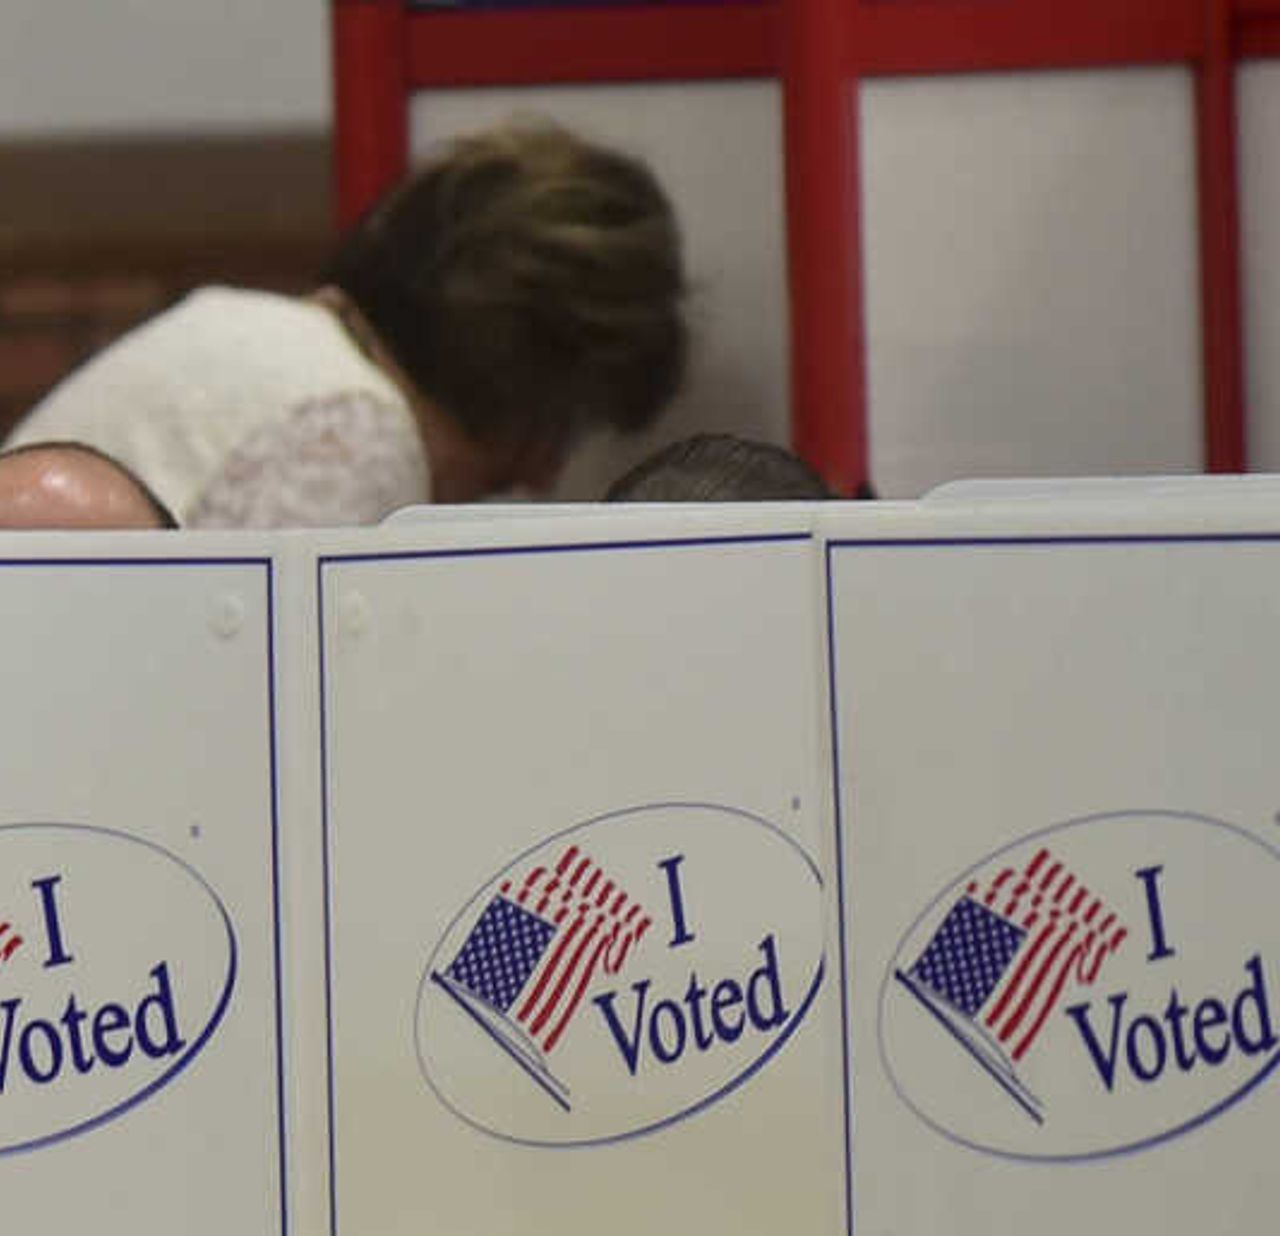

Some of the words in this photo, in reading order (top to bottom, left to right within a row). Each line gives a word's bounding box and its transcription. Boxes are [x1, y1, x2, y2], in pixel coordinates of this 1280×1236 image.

[31, 875, 74, 968] I
[657, 855, 695, 948] I
[1135, 865, 1175, 961] I
[593, 934, 791, 1077] Voted
[1066, 954, 1280, 1093] Voted
